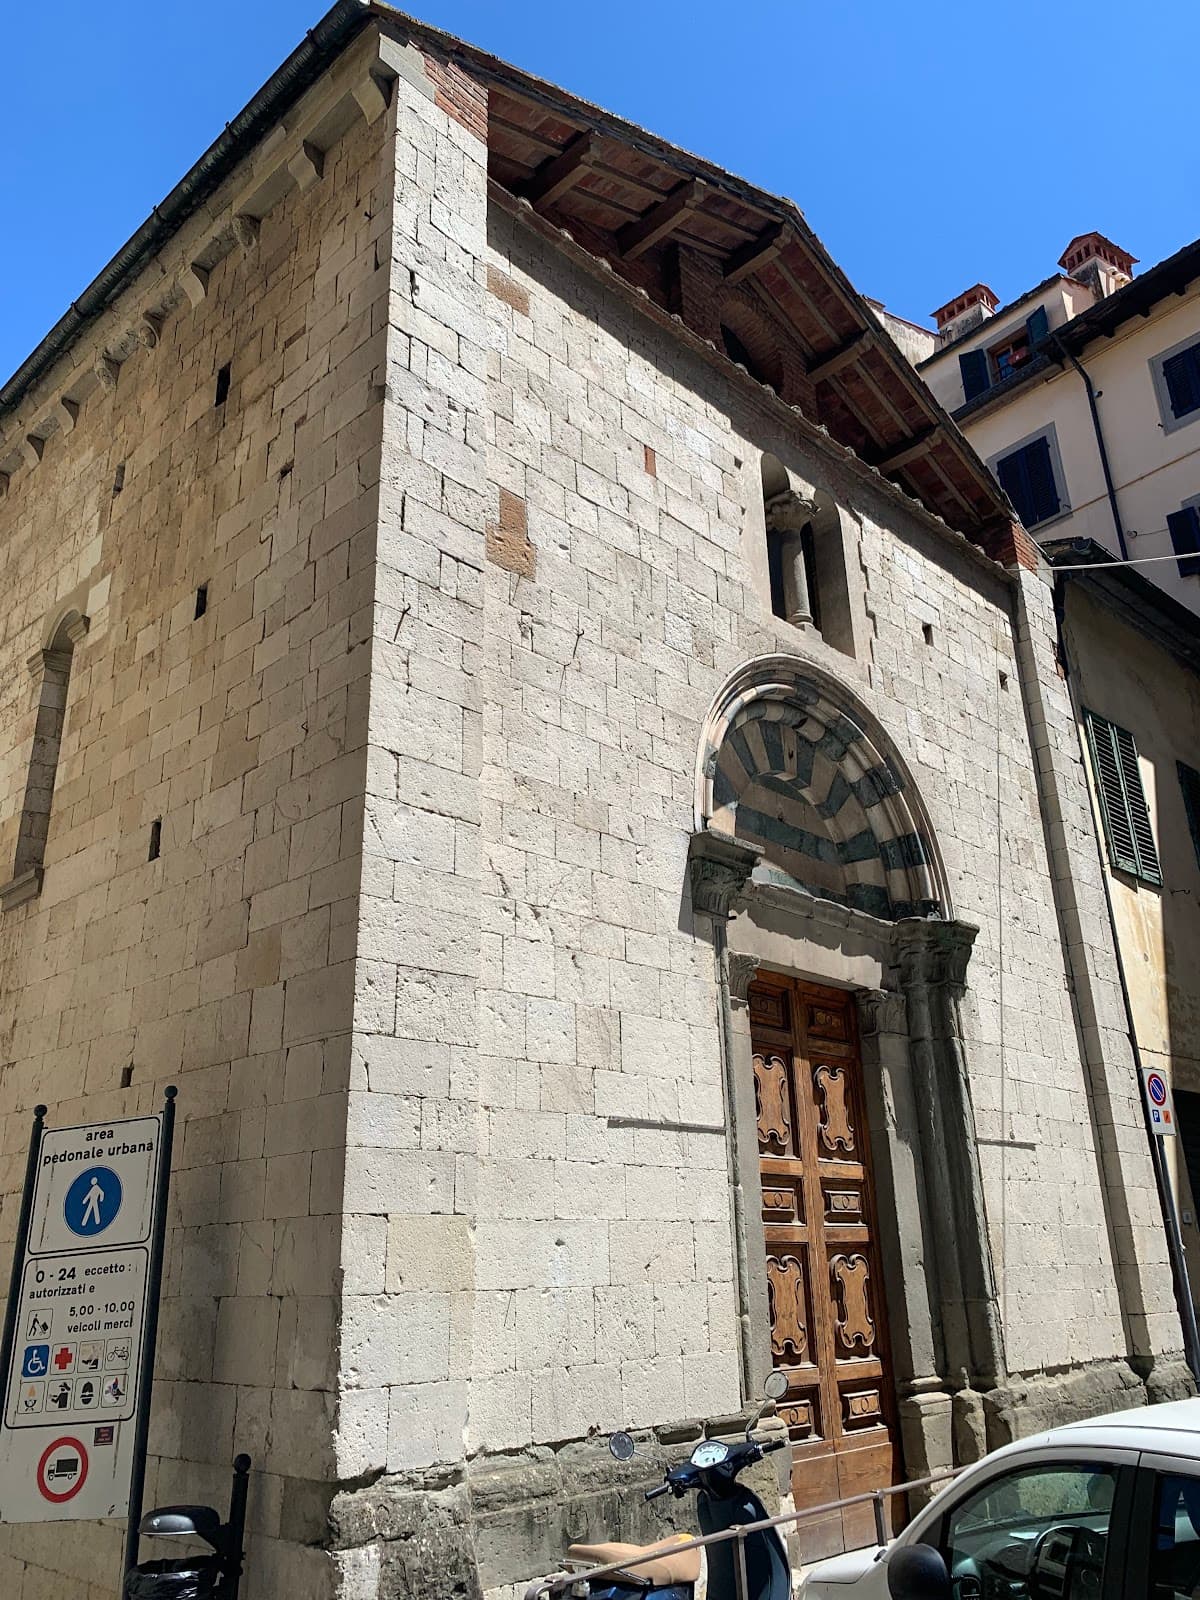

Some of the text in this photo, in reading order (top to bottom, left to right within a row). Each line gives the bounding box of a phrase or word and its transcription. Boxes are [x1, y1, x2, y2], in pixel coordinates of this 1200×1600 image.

[86, 1129, 114, 1141] area
[43, 1142, 154, 1167] pedonale urbana
[58, 1267, 77, 1281] 24
[29, 1283, 95, 1299] autorizzati e
[104, 1300, 135, 1313] 10.00
[67, 1319, 133, 1333] veicoli merci
